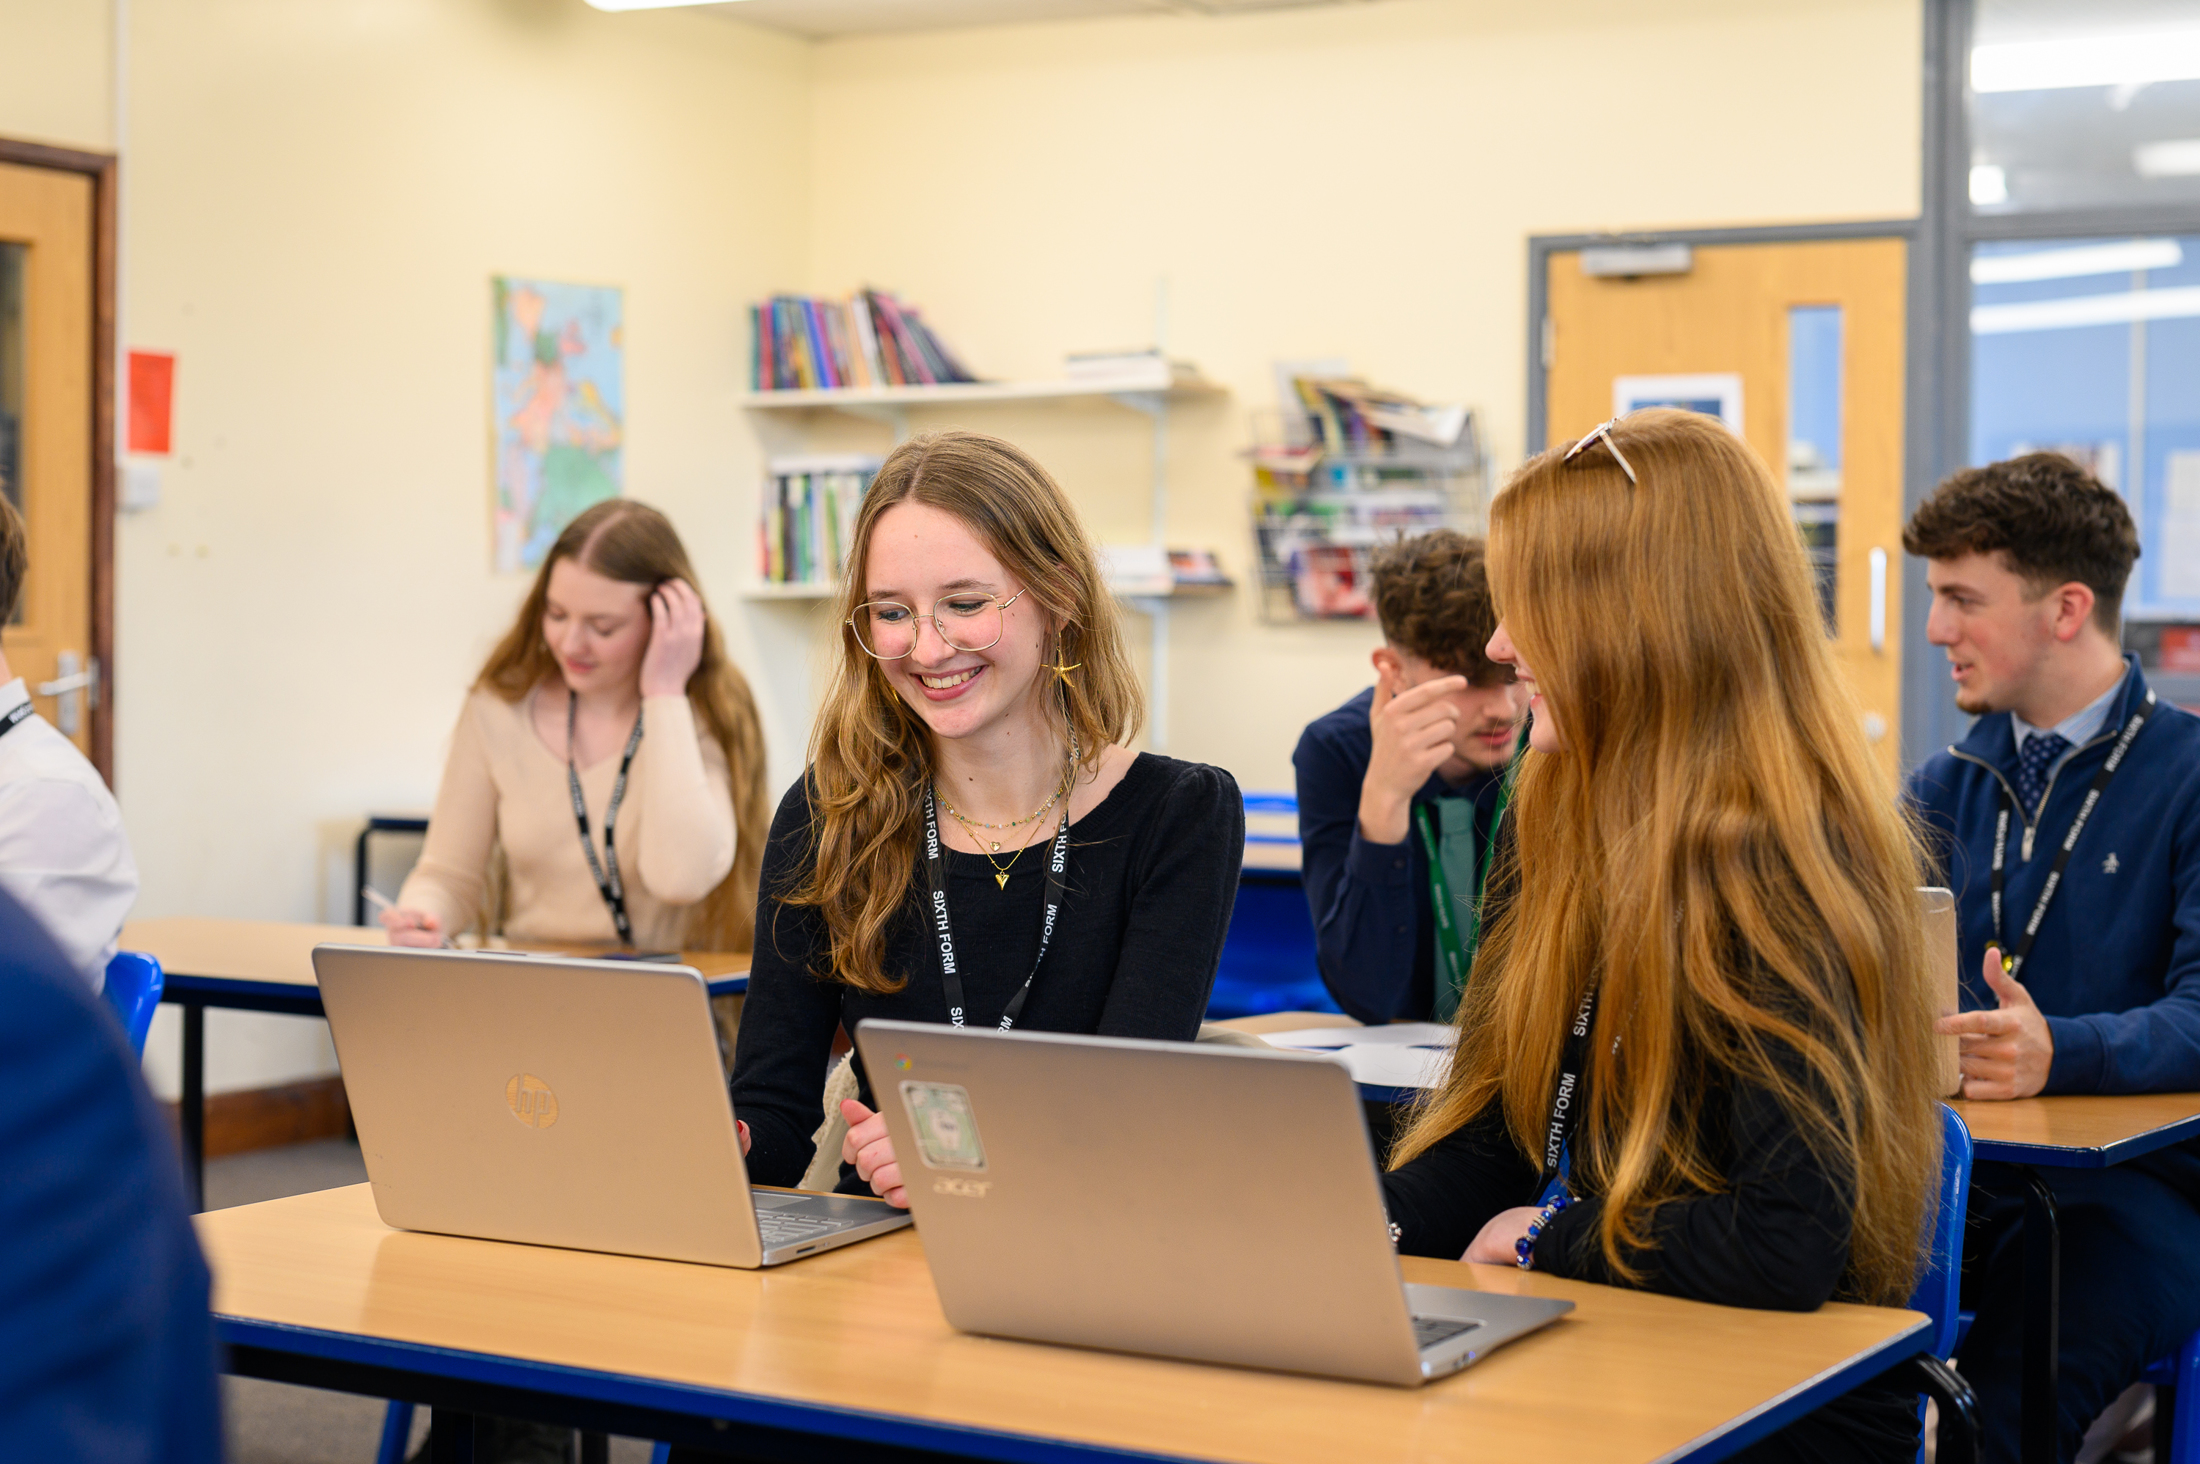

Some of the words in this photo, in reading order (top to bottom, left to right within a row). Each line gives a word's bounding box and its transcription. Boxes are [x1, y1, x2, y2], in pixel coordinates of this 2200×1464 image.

[927, 821, 939, 859] FORM
[1051, 835, 1067, 873] SIXTH
[933, 890, 949, 931] SIXTH
[1043, 903, 1058, 944] FORM
[939, 933, 956, 975] FORM
[1573, 992, 1593, 1037] SIXTH
[514, 1073, 553, 1130] hp
[1553, 1072, 1576, 1119] FORM
[1547, 1121, 1564, 1168] SIXTH
